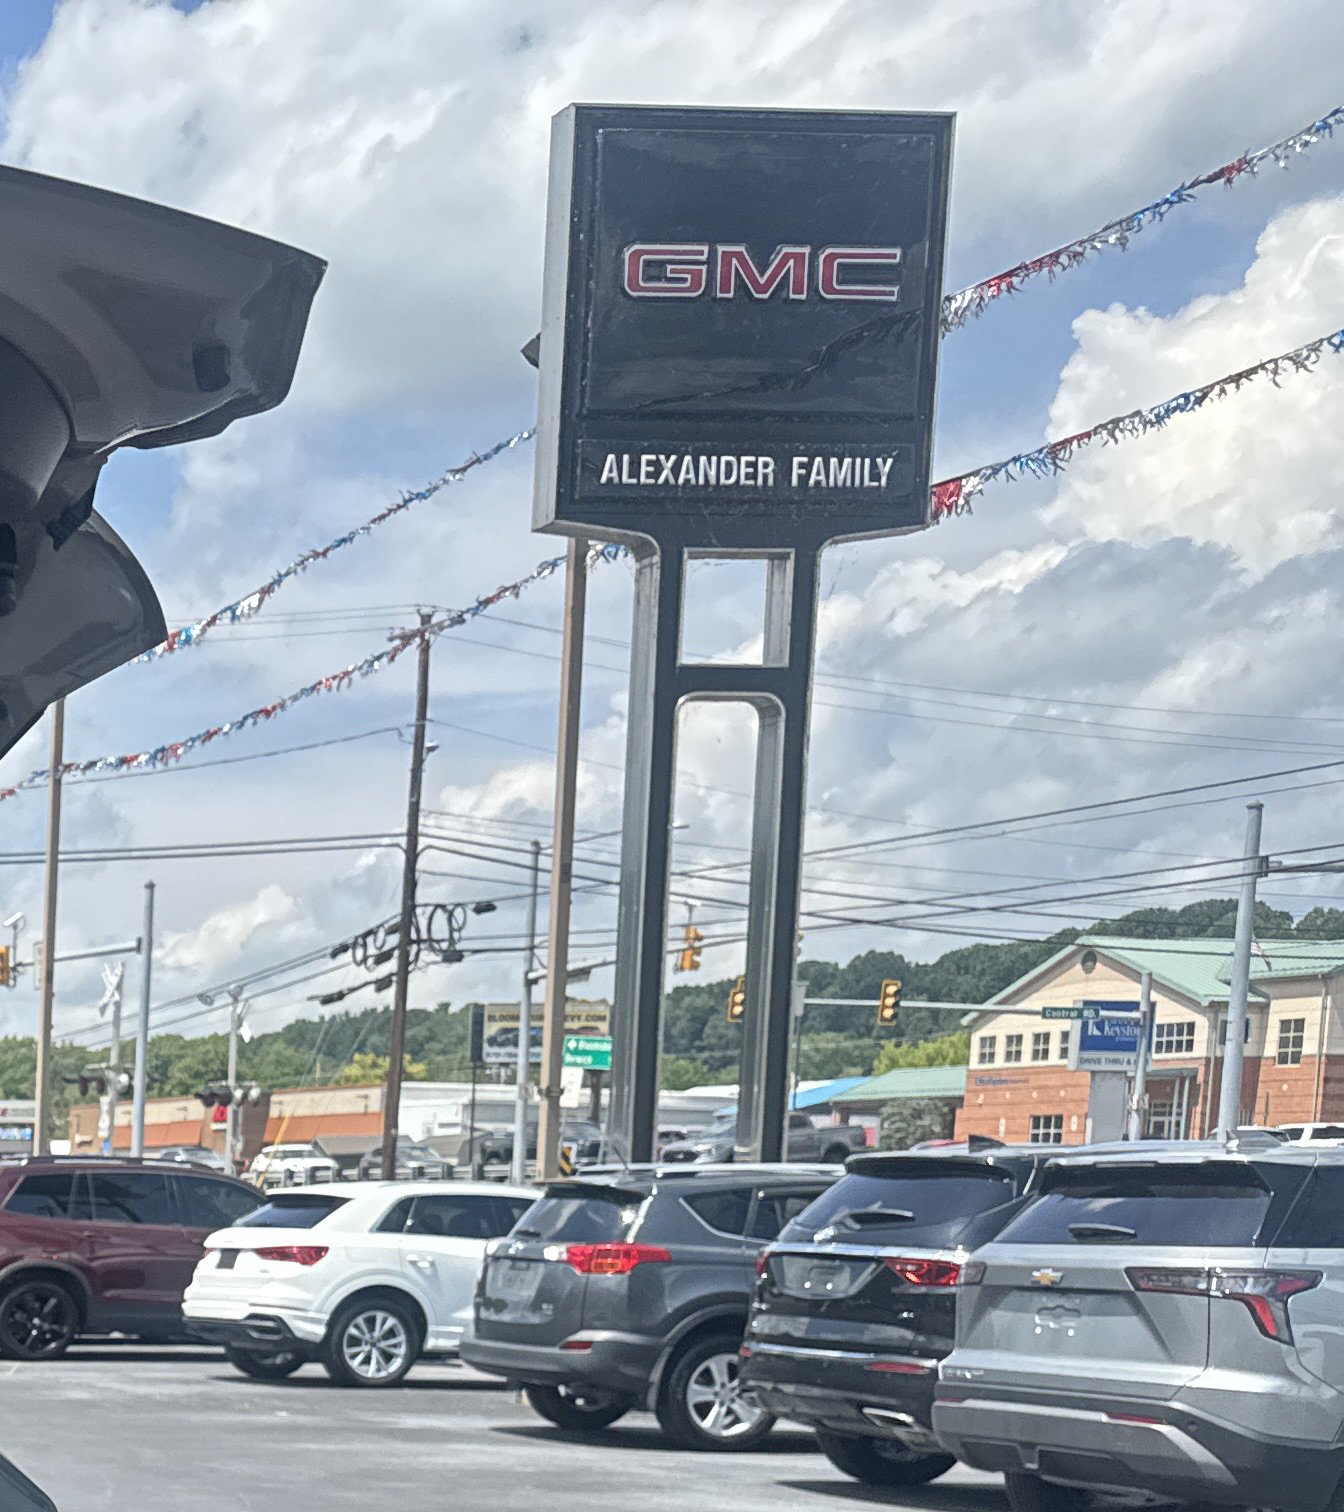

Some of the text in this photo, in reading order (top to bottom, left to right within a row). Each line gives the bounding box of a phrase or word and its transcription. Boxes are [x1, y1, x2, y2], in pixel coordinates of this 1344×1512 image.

[623, 242, 903, 302] GMC
[599, 453, 894, 488] ALEXANDER FAMILY
